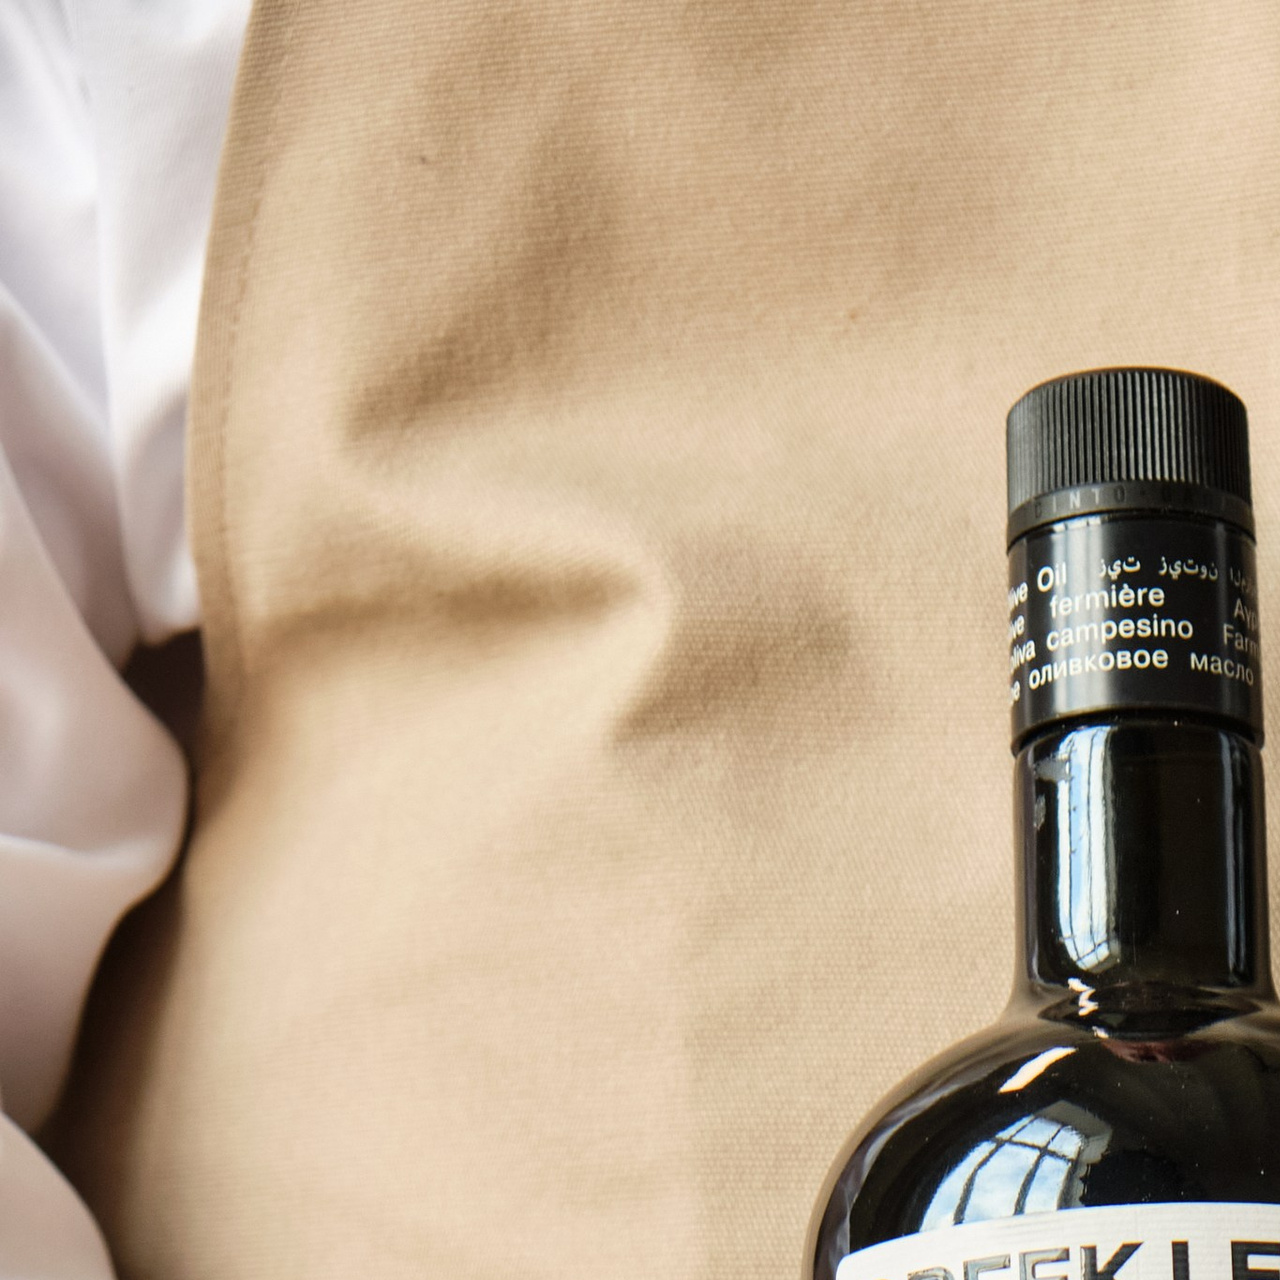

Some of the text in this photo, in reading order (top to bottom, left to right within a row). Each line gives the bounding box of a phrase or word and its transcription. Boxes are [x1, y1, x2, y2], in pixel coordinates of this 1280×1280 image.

[1037, 561, 1067, 592] Oil
[1050, 583, 1165, 618] fermière
[1046, 613, 1194, 650] campesino
[1029, 648, 1254, 690] оливковое масло
